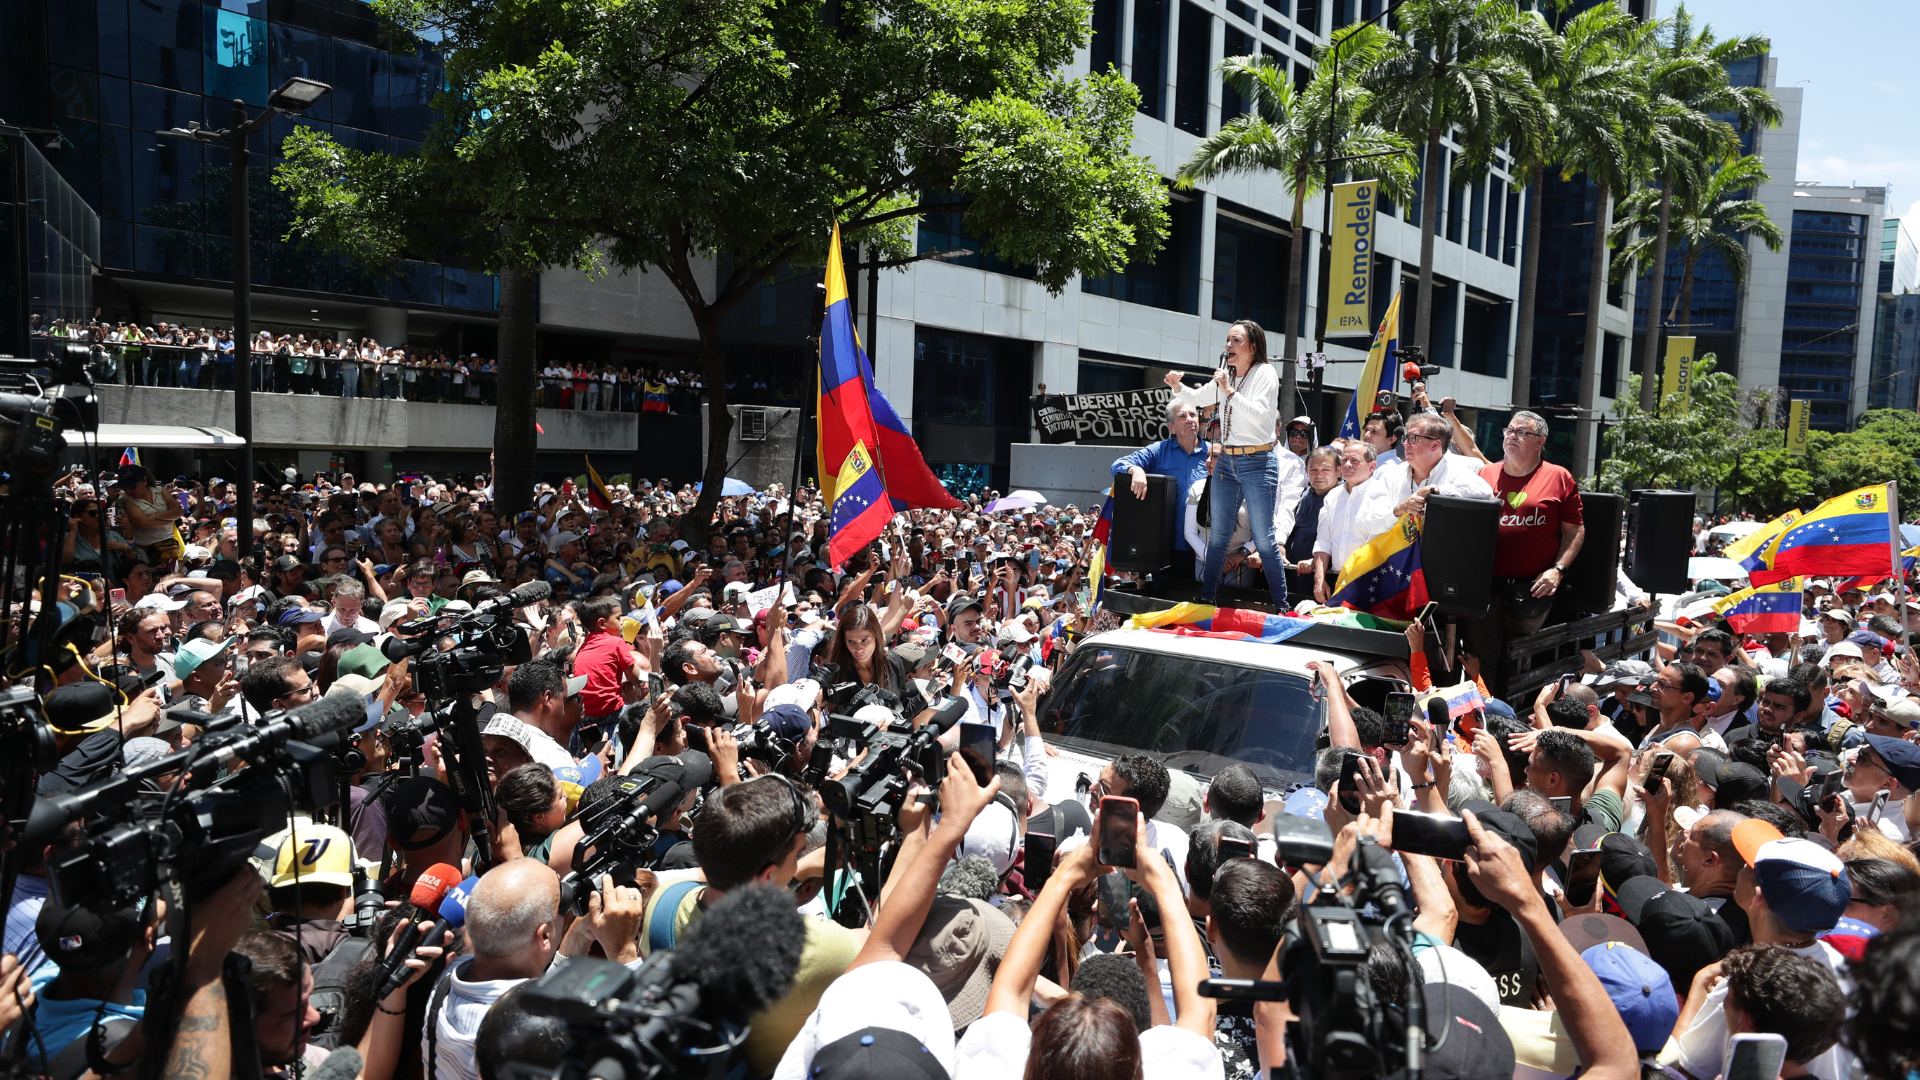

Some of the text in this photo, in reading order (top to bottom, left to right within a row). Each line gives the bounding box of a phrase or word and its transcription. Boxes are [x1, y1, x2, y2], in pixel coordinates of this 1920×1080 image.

[1344, 186, 1371, 305] Remodele
[1339, 316, 1364, 327] EPA
[1065, 393, 1125, 411] LIBEREN
[1131, 392, 1143, 406] A
[453, 770, 466, 795] Canon
